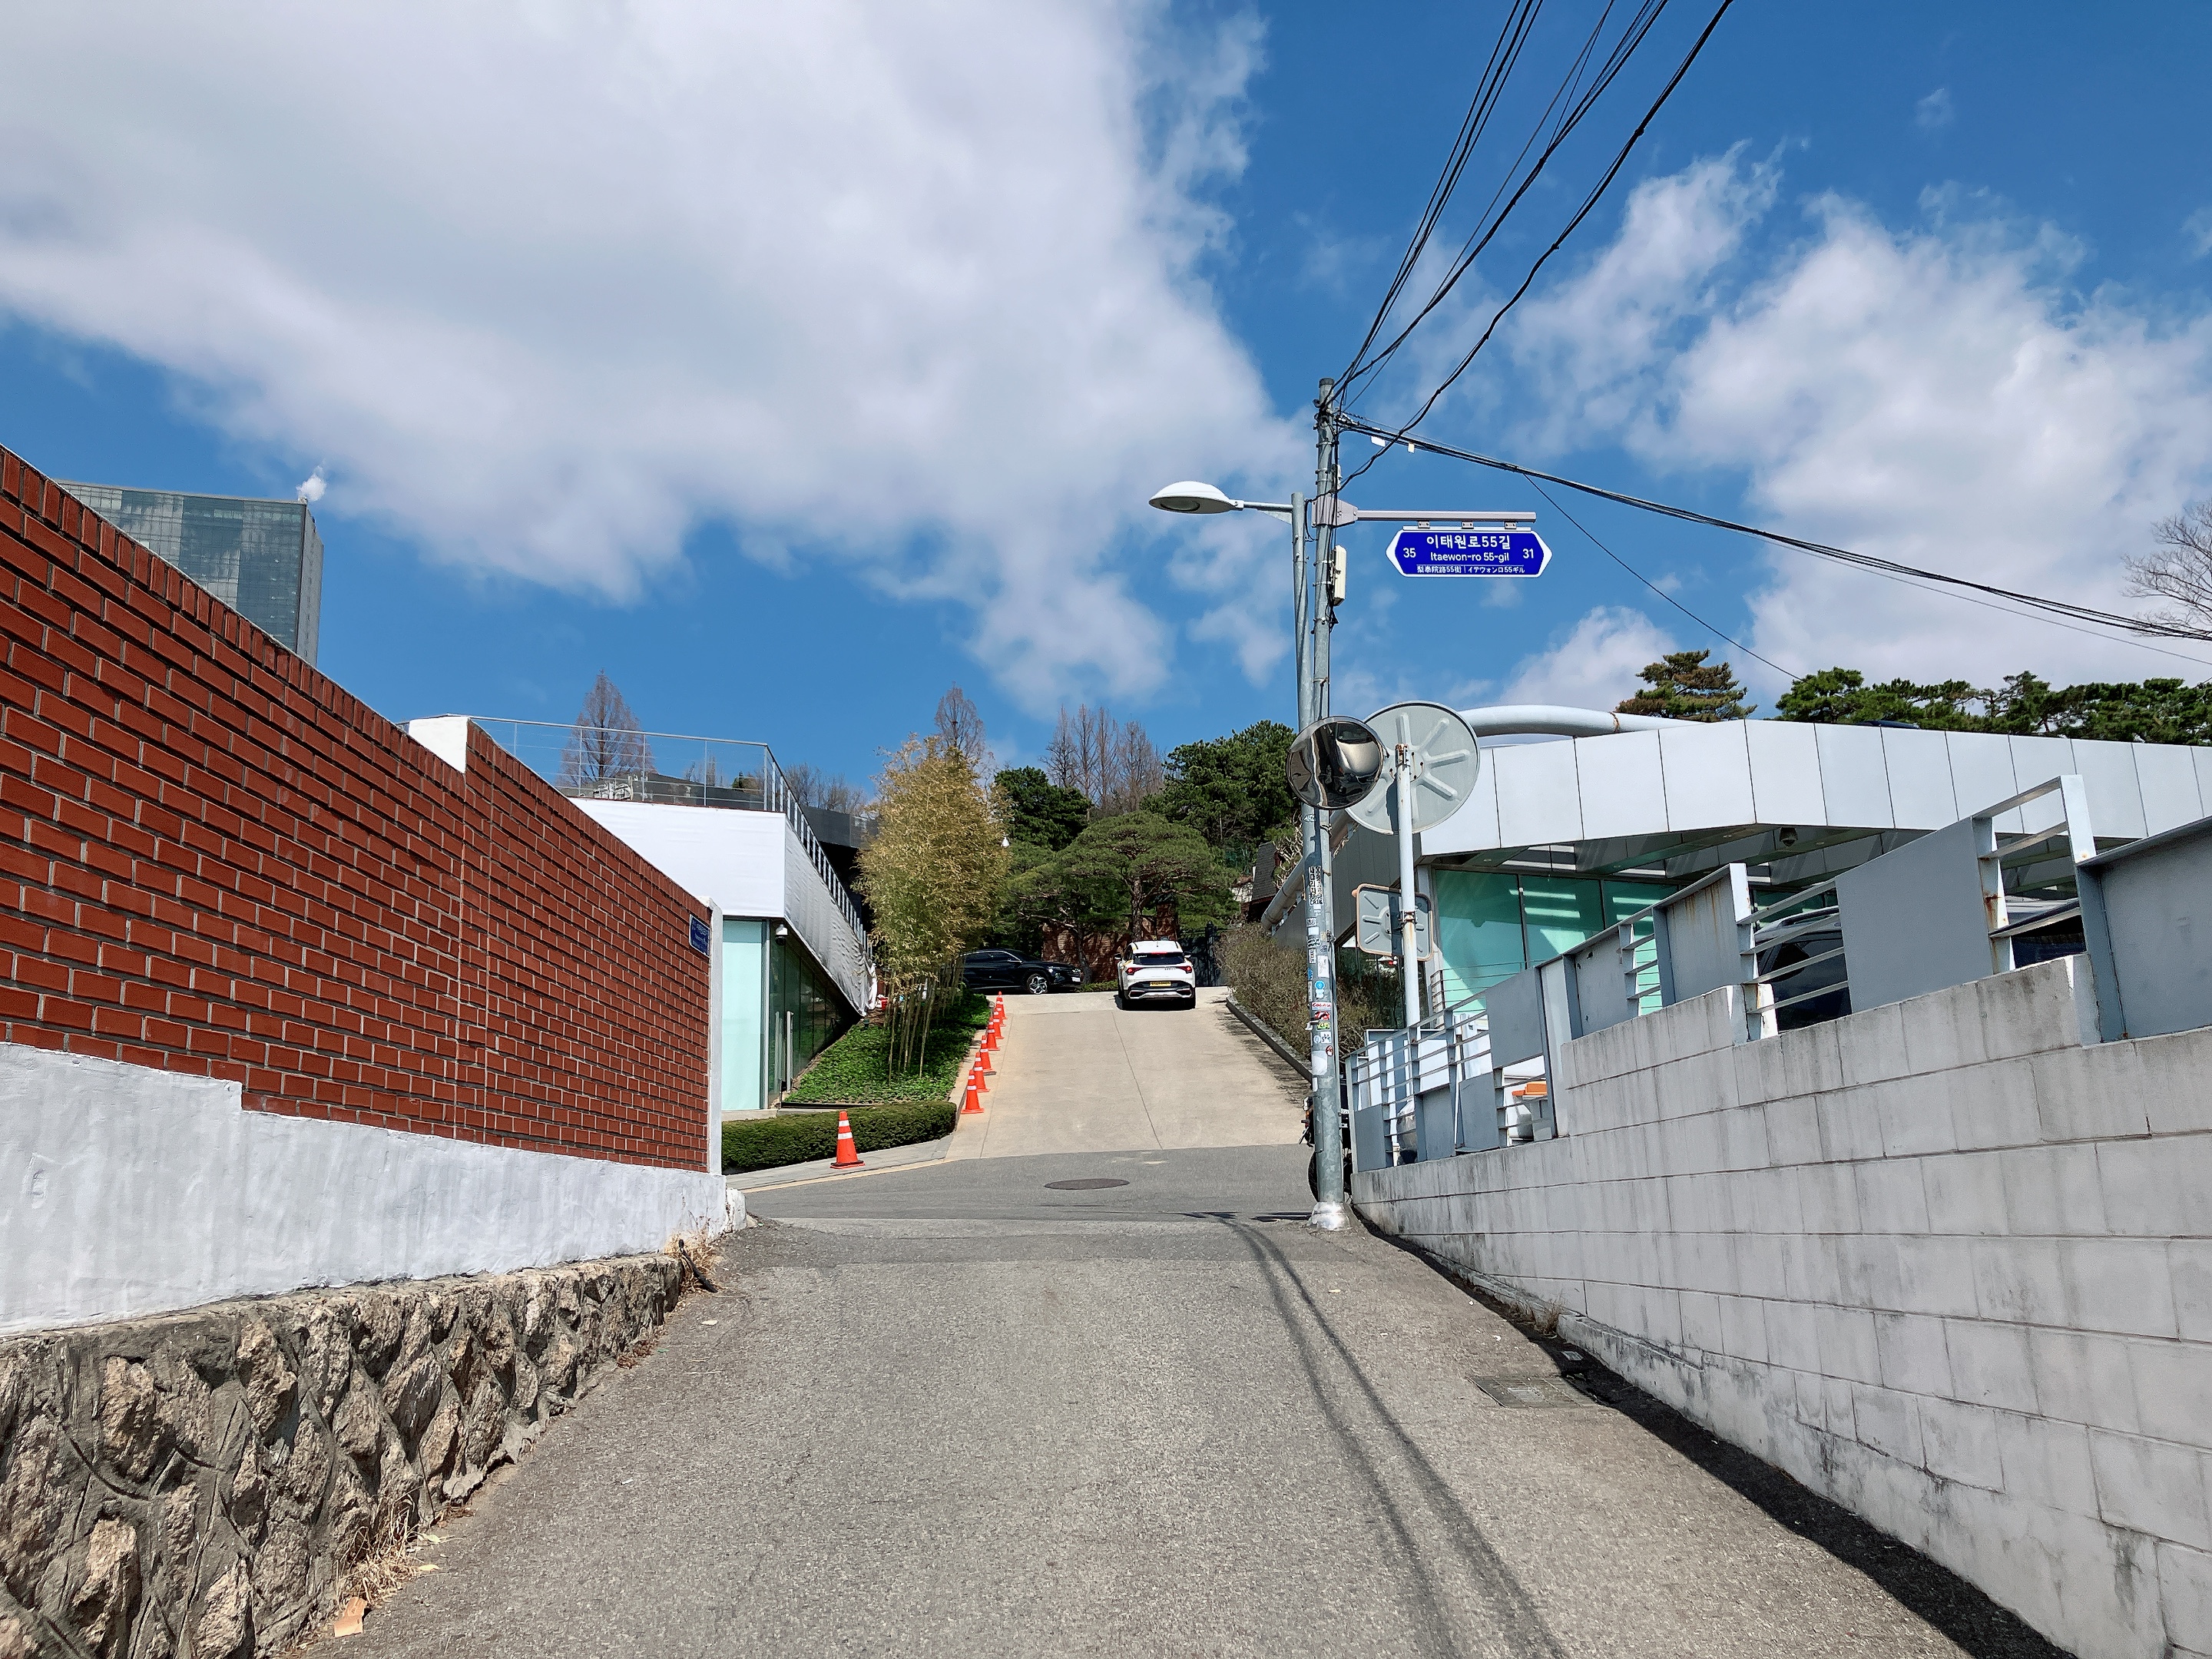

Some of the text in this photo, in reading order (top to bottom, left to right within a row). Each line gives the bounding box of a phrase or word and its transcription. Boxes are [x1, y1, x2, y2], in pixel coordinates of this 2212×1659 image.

[1427, 535, 1510, 550] 이태원로55길
[1402, 548, 1416, 558] 35
[1431, 551, 1510, 564] Itaewon-ro 55-gil
[1522, 548, 1535, 559] 31
